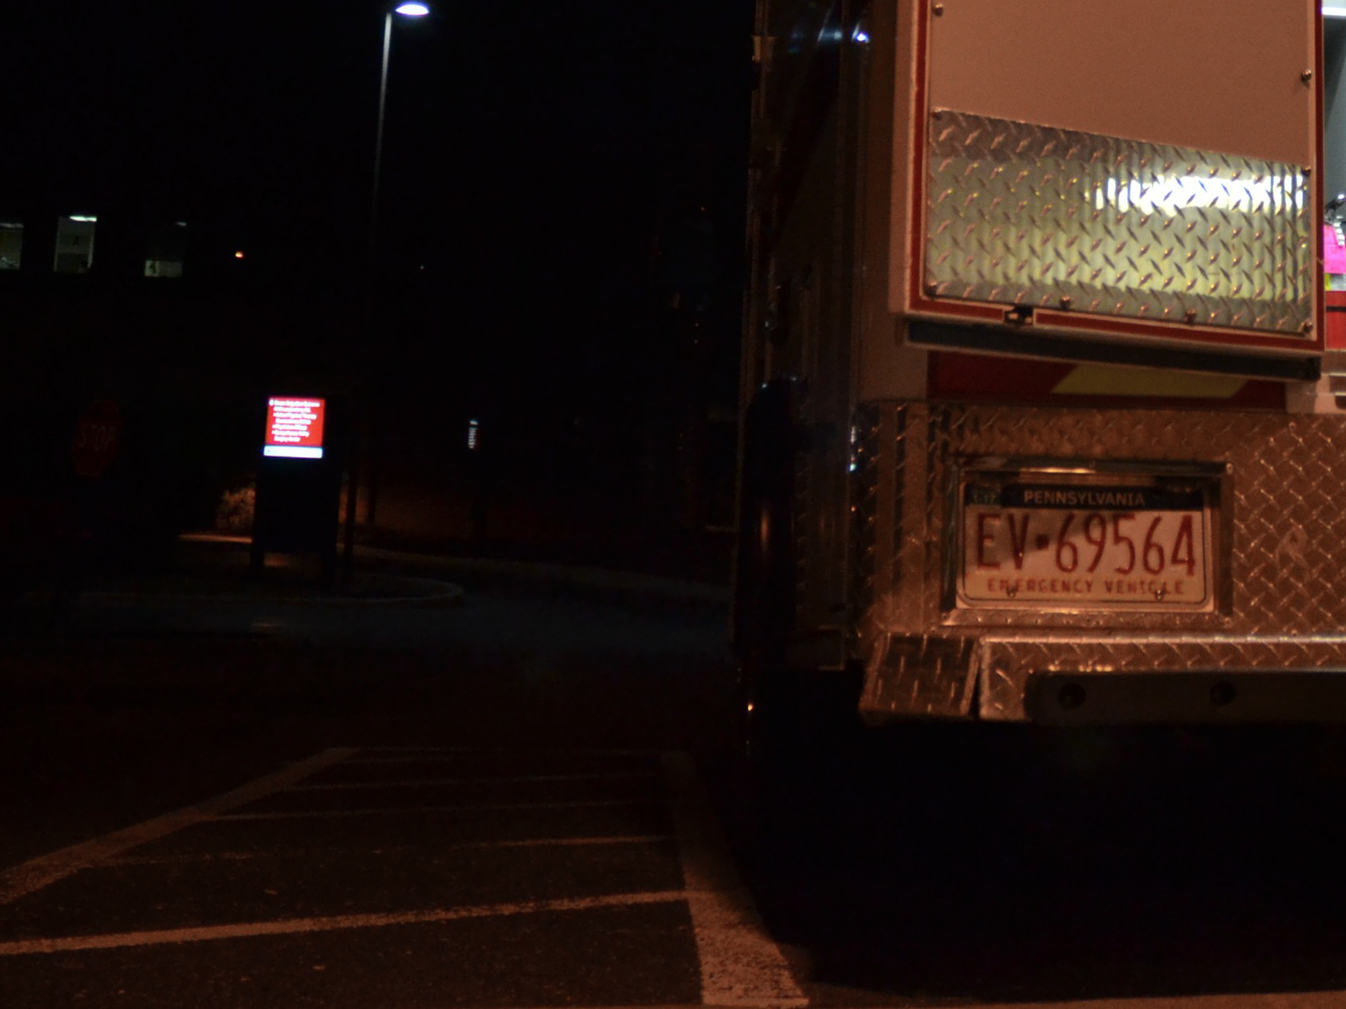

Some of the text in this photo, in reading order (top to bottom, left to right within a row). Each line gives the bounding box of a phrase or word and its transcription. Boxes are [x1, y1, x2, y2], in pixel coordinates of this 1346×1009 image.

[76, 423, 117, 452] STOP
[1023, 490, 1146, 507] PENNSYLVANIA
[987, 578, 1094, 594] EMERGENCY
